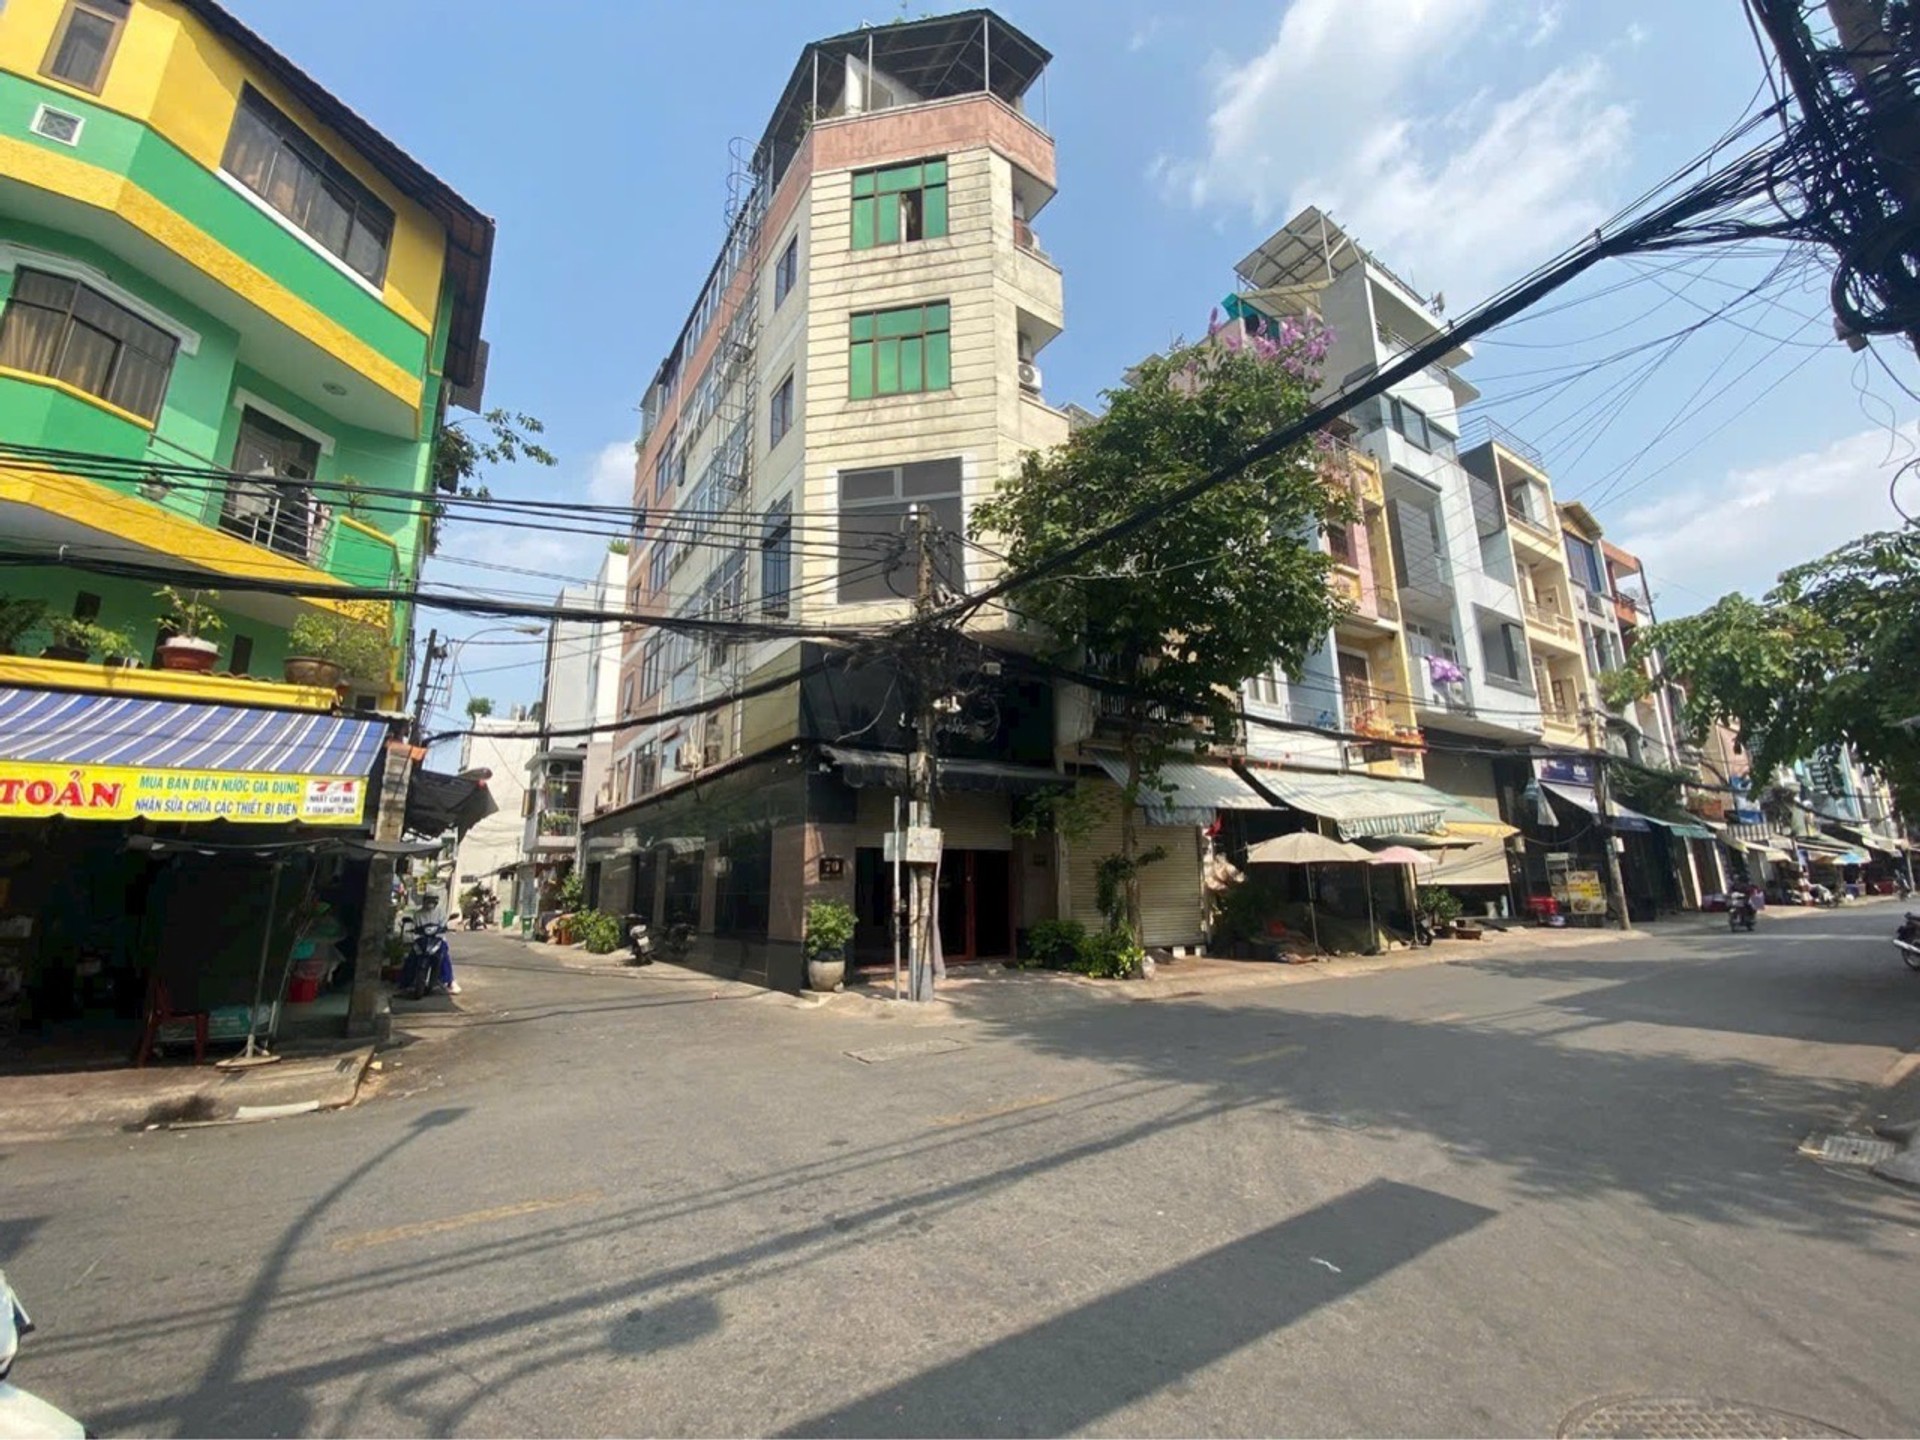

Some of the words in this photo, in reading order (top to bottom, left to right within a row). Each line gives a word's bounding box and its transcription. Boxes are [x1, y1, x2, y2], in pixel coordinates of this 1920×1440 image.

[0, 769, 122, 808] TOẢN
[140, 775, 163, 789] MUA
[167, 775, 190, 790] BÁN
[253, 779, 269, 793] GIA
[164, 794, 183, 813] SỬA
[214, 798, 233, 814] CÁC
[236, 799, 262, 815] THIẾT
[264, 802, 275, 817] BỊ
